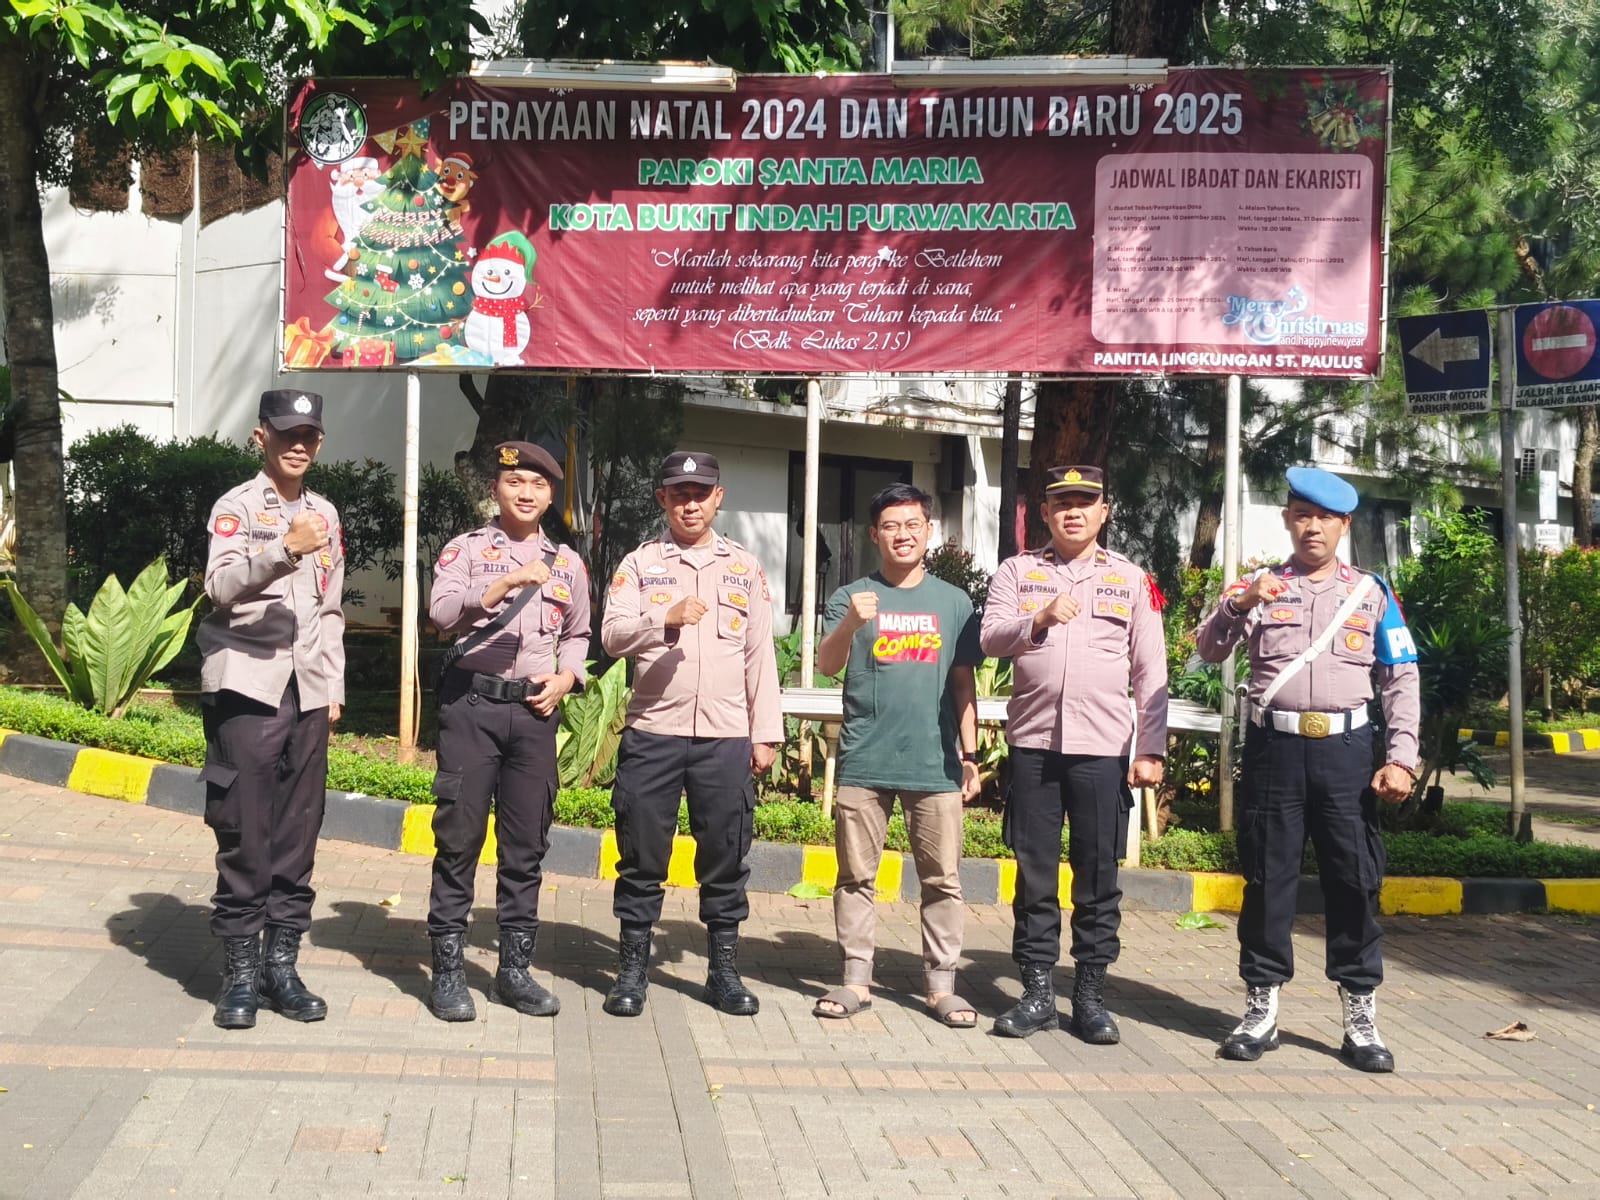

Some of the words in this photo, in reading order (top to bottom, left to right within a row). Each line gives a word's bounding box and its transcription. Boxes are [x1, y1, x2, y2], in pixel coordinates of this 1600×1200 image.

[450, 100, 615, 140] PERAYAAN
[630, 99, 731, 140] NATAL
[741, 98, 827, 140] 2024
[839, 97, 907, 139] DAN
[920, 96, 1034, 138] TAHUN
[1048, 94, 1141, 137] BARU
[1153, 92, 1243, 135] 2025
[638, 158, 753, 185] PAROKI
[759, 157, 868, 185] SANTA
[871, 157, 984, 185] MARIA
[1110, 169, 1176, 189] JADWAL
[1181, 168, 1239, 188] IBADAT
[1245, 169, 1279, 189] DAN
[1285, 169, 1361, 190] EKARISTI
[549, 204, 634, 231] KOTA
[637, 204, 732, 231] BUKIT
[735, 204, 842, 231] INDAH
[848, 203, 1076, 231] PURWAKARTA
[735, 250, 807, 275] sekarang
[810, 249, 842, 268] kita
[843, 254, 884, 275] pergi
[888, 249, 909, 268] ke
[914, 248, 1003, 268] Betlehem
[670, 276, 716, 295] untuk
[719, 276, 776, 295] melihat
[779, 282, 810, 301] apa
[810, 281, 856, 302] yang
[859, 276, 910, 302] terjadi
[912, 276, 929, 295] di
[933, 282, 973, 297] sana,
[633, 305, 681, 328] seperti
[681, 308, 725, 329] yang
[728, 303, 836, 322] diberitahukan
[842, 302, 903, 323] Tuhan
[908, 304, 967, 330] kepada
[1223, 293, 1290, 325] Merry
[801, 329, 860, 351] Lukas
[1243, 312, 1366, 346] Christmas
[1094, 352, 1158, 366] PANITIA
[1162, 352, 1272, 367] LINGKUNGAN
[1275, 355, 1298, 368] ST.
[1302, 355, 1363, 369] PAULUS
[1408, 392, 1447, 403] PARKIR
[1449, 390, 1488, 400] MOTOR
[1516, 387, 1553, 398] JALUR
[1516, 398, 1564, 408] DILARANG
[1412, 403, 1450, 414] PARKIR
[1452, 401, 1486, 411] MOBIL
[484, 563, 510, 573] RIZKI
[550, 568, 573, 583] OLRI
[722, 575, 752, 590] POLRI
[1096, 587, 1130, 599] POLRI
[879, 613, 936, 632] MARVEL
[873, 633, 942, 657] COMICS
